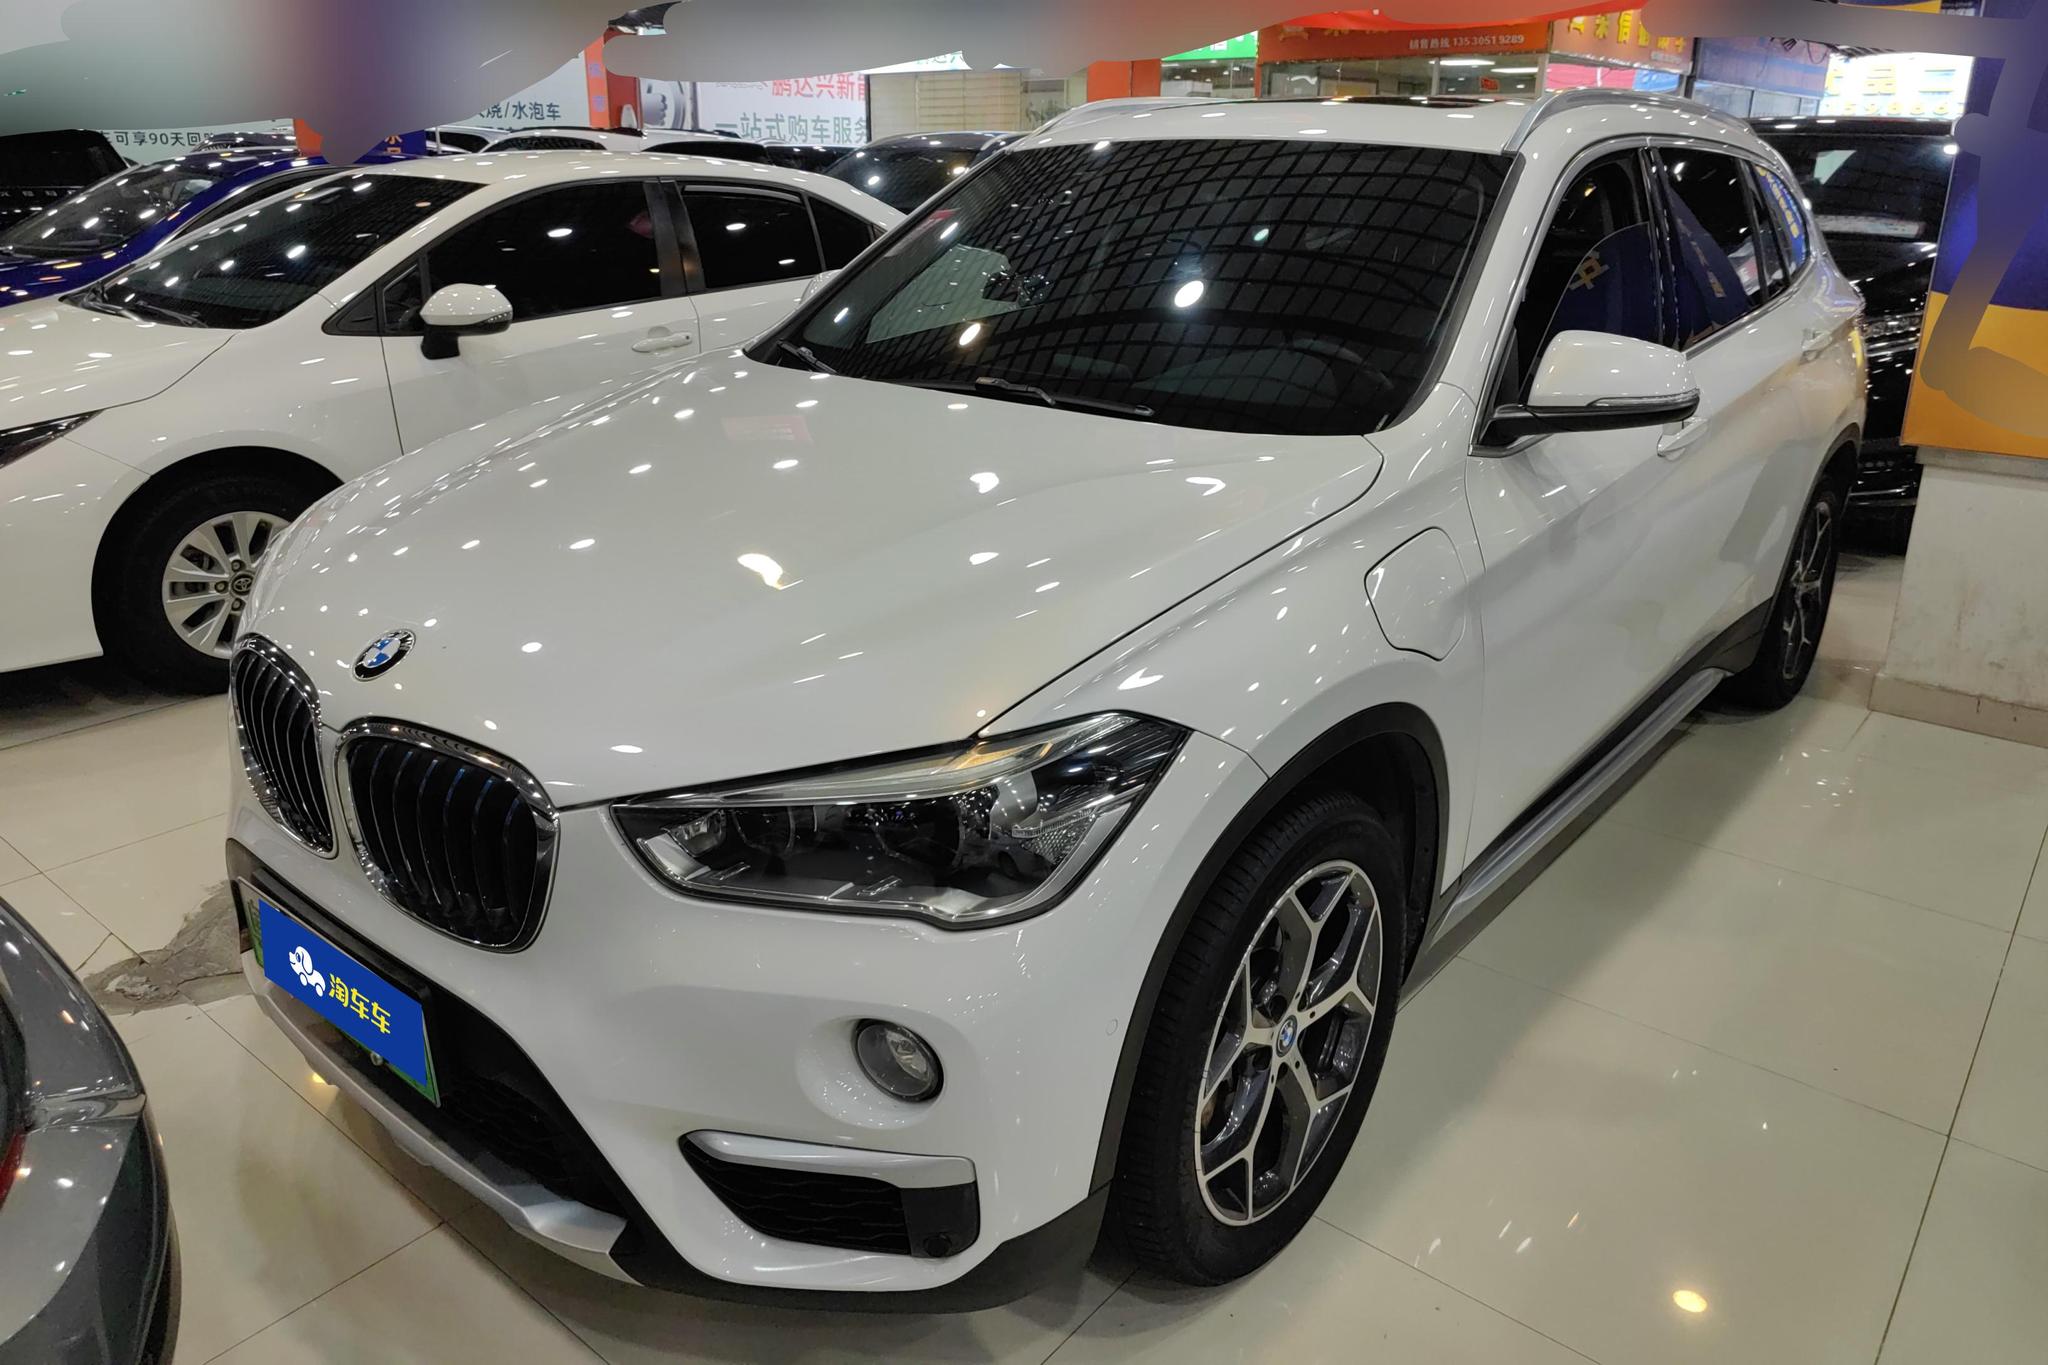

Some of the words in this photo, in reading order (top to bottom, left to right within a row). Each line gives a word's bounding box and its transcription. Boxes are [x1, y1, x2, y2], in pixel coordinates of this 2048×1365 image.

[479, 101, 561, 121] 烧/水泡车
[101, 131, 212, 146] 可享90天回
[715, 112, 867, 145] 一站式购车服务
